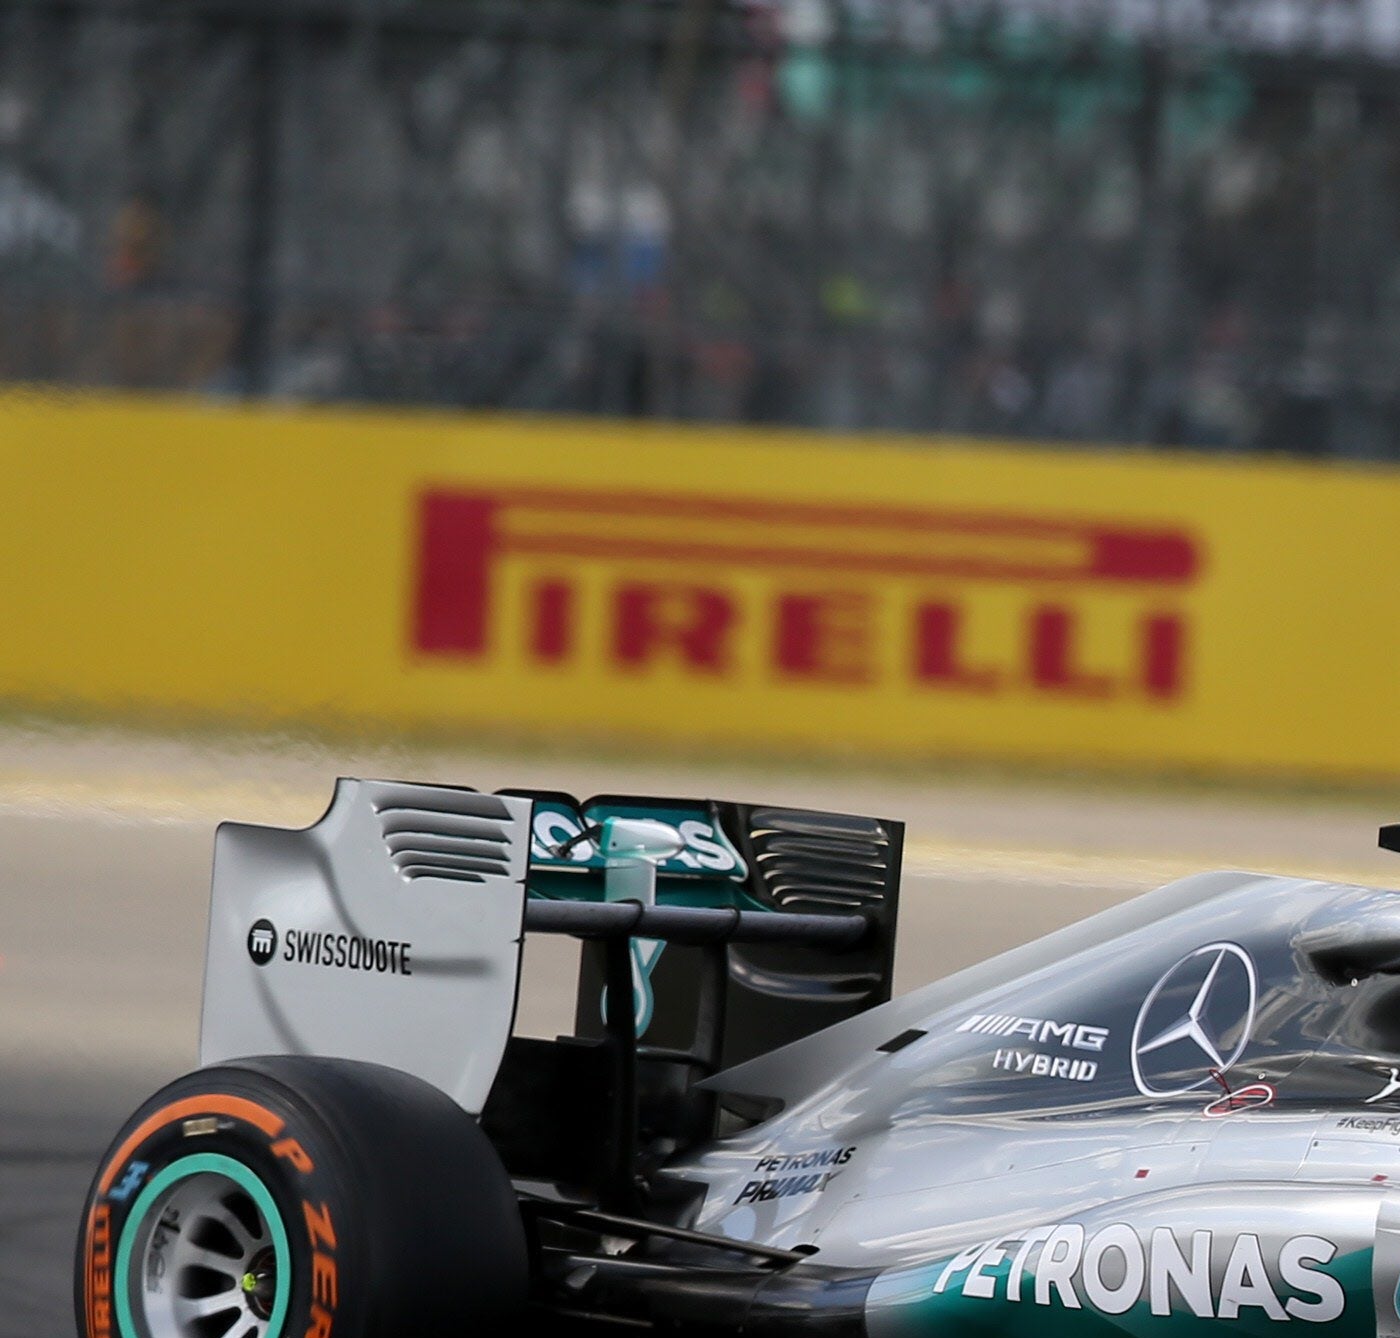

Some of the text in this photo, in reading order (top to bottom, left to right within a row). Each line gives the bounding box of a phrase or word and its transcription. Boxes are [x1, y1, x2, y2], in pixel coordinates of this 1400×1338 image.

[408, 487, 1204, 702] PIRELLI
[283, 929, 412, 976] SWISSQUOTE
[1001, 1016, 1110, 1052] AMG
[992, 1048, 1098, 1082] HYBRID
[754, 1147, 857, 1172] PETRONAS
[931, 1222, 1346, 1323] PETRONAS
